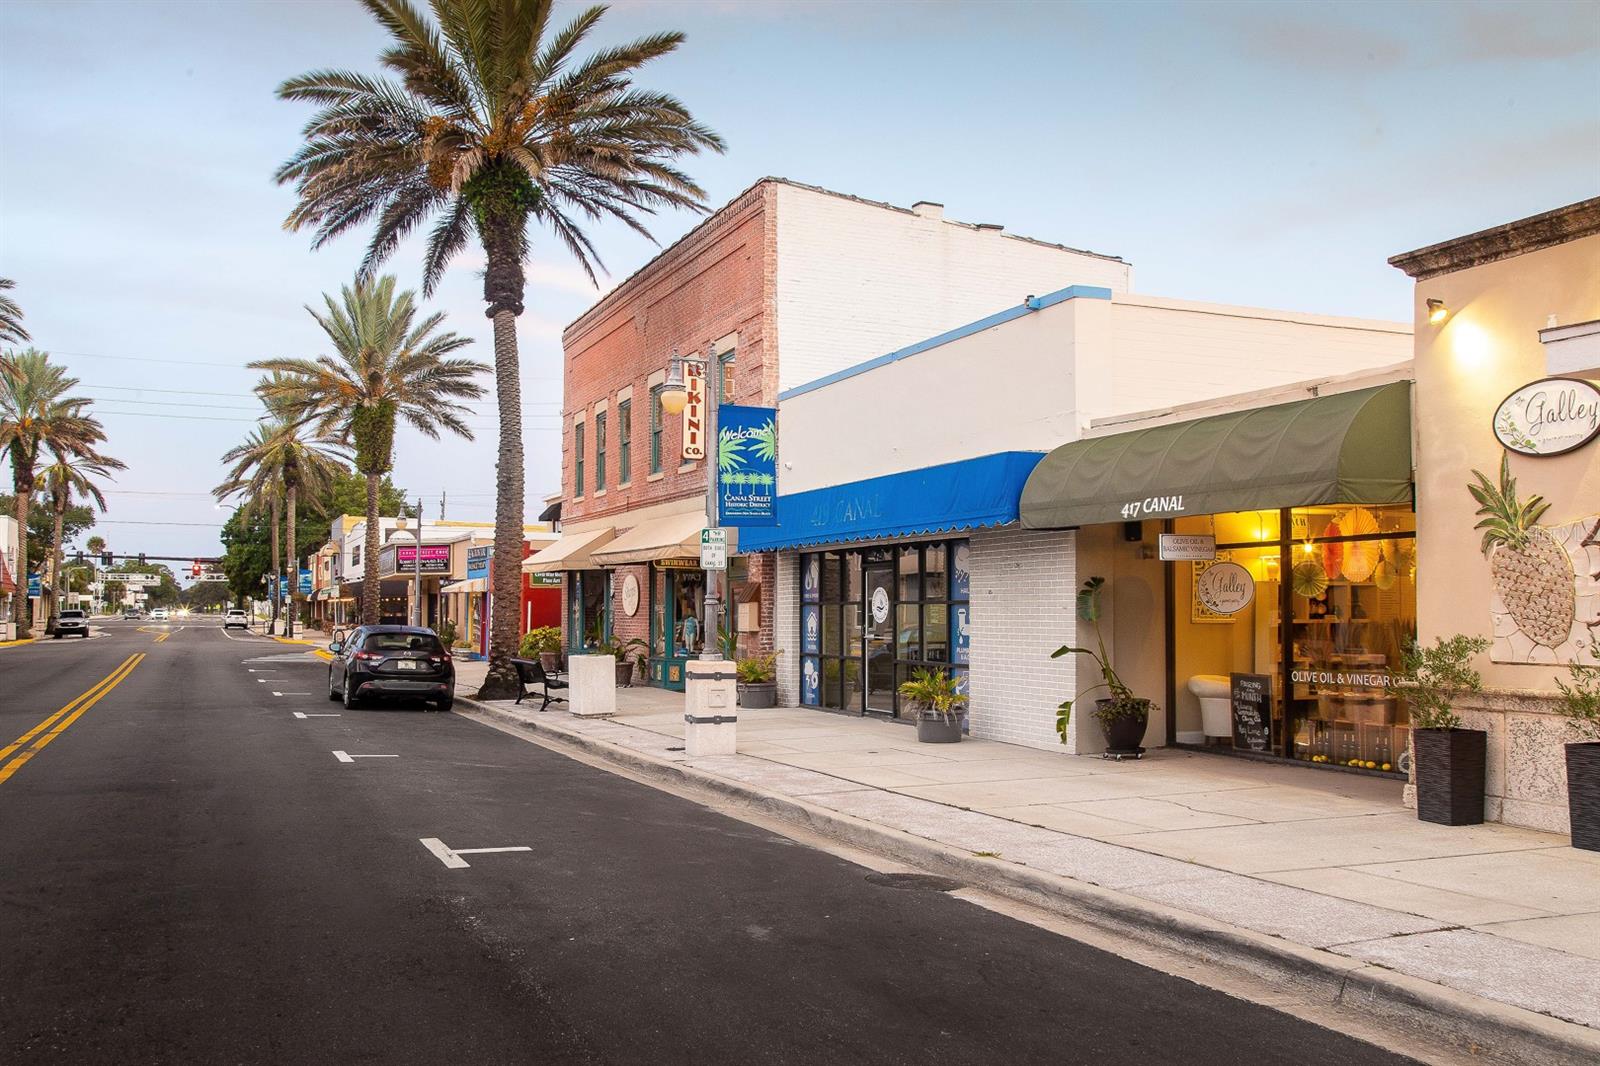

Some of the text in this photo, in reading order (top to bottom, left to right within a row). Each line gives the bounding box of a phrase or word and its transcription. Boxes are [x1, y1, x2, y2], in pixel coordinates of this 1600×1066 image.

[1525, 388, 1598, 436] Galley
[685, 446, 703, 455] CO.
[835, 494, 881, 522] CANAL
[1121, 496, 1185, 519] 417 CANAL
[702, 530, 709, 541] 4
[1212, 570, 1246, 601] Galley
[1291, 671, 1318, 683] OLIVE
[1319, 672, 1336, 684] OIL
[1336, 673, 1345, 684] &
[1346, 673, 1391, 687] VINEGAR
